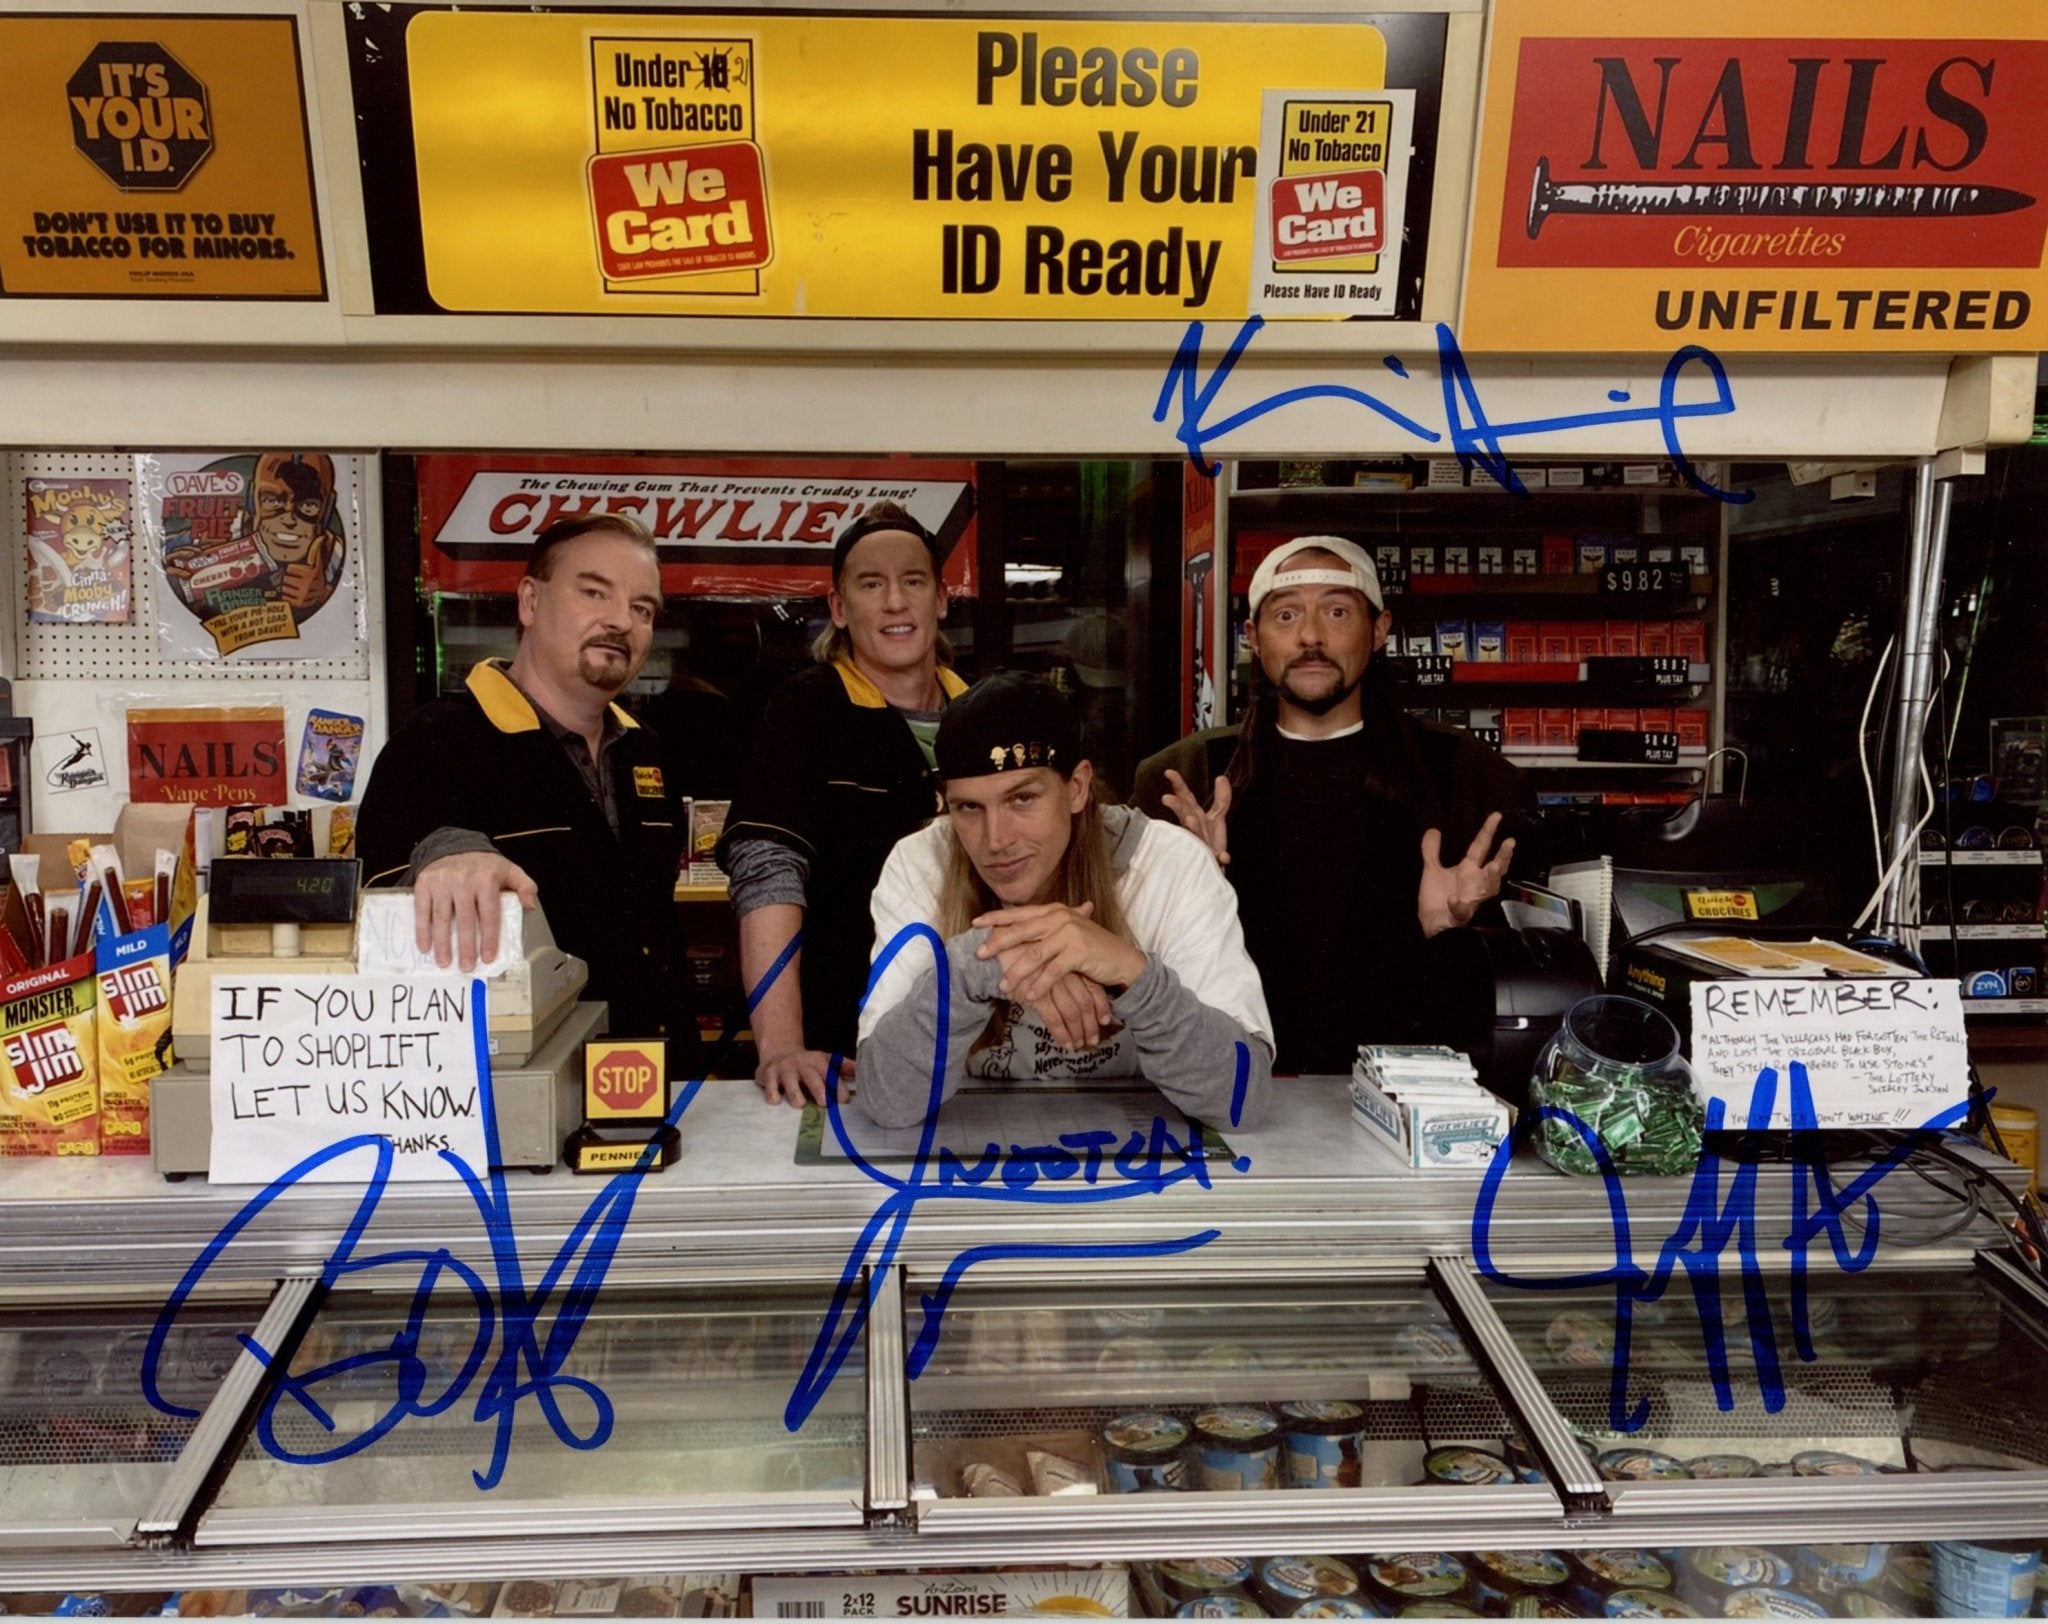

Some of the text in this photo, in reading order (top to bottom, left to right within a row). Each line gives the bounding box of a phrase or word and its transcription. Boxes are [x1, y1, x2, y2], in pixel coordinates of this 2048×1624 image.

[99, 63, 169, 97] IT'S
[615, 53, 690, 87] Under
[977, 31, 1198, 106] Please
[70, 97, 210, 140] YOUR
[604, 96, 743, 131] No Tobacco
[1299, 110, 1375, 133] Under 21
[1580, 56, 1996, 172] NAILS
[121, 139, 174, 172] I.D.
[1289, 138, 1381, 162] No Tobacco
[913, 129, 1257, 203] Have Your
[623, 159, 727, 208] We
[1294, 180, 1362, 213] We
[33, 212, 275, 236] DON'T USE IT TO BUY
[606, 200, 753, 254] Card
[1278, 207, 1376, 245] Card
[23, 236, 295, 260] TOBACCO FOR MINORS.
[1673, 225, 1846, 263] Cigarettes
[942, 224, 1221, 308] ID Ready
[1263, 284, 1381, 301] Please Have ID Ready
[1655, 290, 2031, 330] UNFILTERED
[519, 478, 918, 500] The Chewing Gum That Prevents Cruddy Lung!
[162, 497, 241, 518] FRUIT
[191, 518, 231, 539] PIE
[64, 583, 112, 603] Mooby
[241, 622, 247, 630] A
[1433, 673, 1445, 683] TAX
[1672, 674, 1684, 684] TAX
[137, 741, 279, 779] NAILS
[1662, 750, 1674, 759] TAX
[160, 784, 256, 802] Vape Pens
[296, 877, 336, 894] 420
[116, 940, 148, 957] MILD
[6, 968, 70, 994] ORIGINAL
[5, 987, 75, 1030] MONSTER
[219, 984, 465, 1026] IF YOU PLAN
[1705, 981, 1939, 1028] REMEMBER:
[1760, 1033, 1779, 1045] THE
[1834, 1032, 1853, 1043] HAD
[1855, 1029, 1908, 1043] FORGOTTEN
[1910, 1030, 1928, 1041] THE
[219, 1032, 443, 1073] TO SHOPLIFT,
[1707, 1047, 1729, 1059] AND
[1734, 1047, 1758, 1058] LOST
[1762, 1047, 1782, 1057] THE
[1787, 1045, 1838, 1057] ORIGINAL
[1841, 1045, 1871, 1057] BLACK
[598, 1065, 652, 1096] STOP
[1708, 1061, 1735, 1078] THEY
[1842, 1059, 1855, 1069] TO
[1859, 1059, 1879, 1070] USE
[1864, 1072, 1935, 1087] THE LOTTERY
[230, 1080, 477, 1120] LET US KNOW.
[1848, 1112, 1889, 1122] WHINE
[590, 1149, 652, 1163] PENNIES
[924, 1581, 979, 1595] AriZona
[843, 1608, 875, 1616] PACK
[896, 1594, 1007, 1616] SUNRISE
